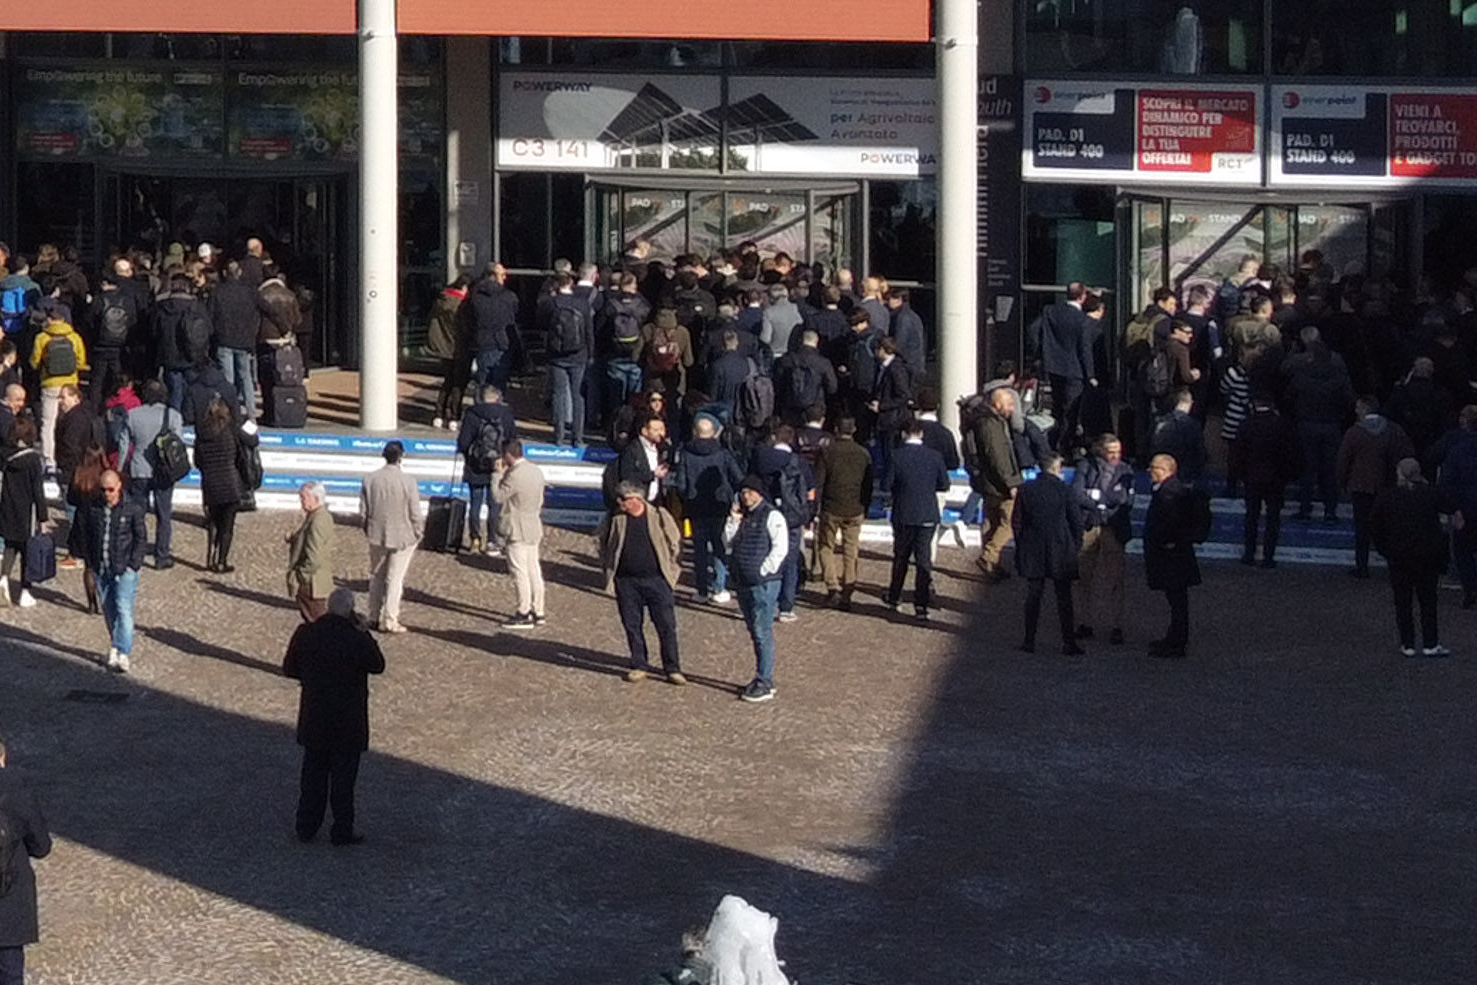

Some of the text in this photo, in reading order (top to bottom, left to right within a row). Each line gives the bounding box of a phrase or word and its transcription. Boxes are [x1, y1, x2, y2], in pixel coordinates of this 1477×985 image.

[513, 80, 593, 92] POWERWAY
[1197, 99, 1249, 112] MERCATO
[1433, 104, 1442, 117] A
[1142, 111, 1223, 125] DINAMICO PER
[1037, 128, 1066, 141] PAD.
[1142, 124, 1213, 138] DISTINGUERE
[1142, 138, 1180, 151] LA TUA
[1286, 134, 1316, 147] PAD.
[1394, 135, 1458, 149] PRODOTTI
[513, 137, 588, 158] C3 141
[1037, 143, 1105, 158] STAND 400
[860, 152, 937, 164] POWERWA
[1286, 148, 1356, 164] STAND 400
[1406, 151, 1456, 165] GADGET
[1218, 158, 1243, 169] RCT
